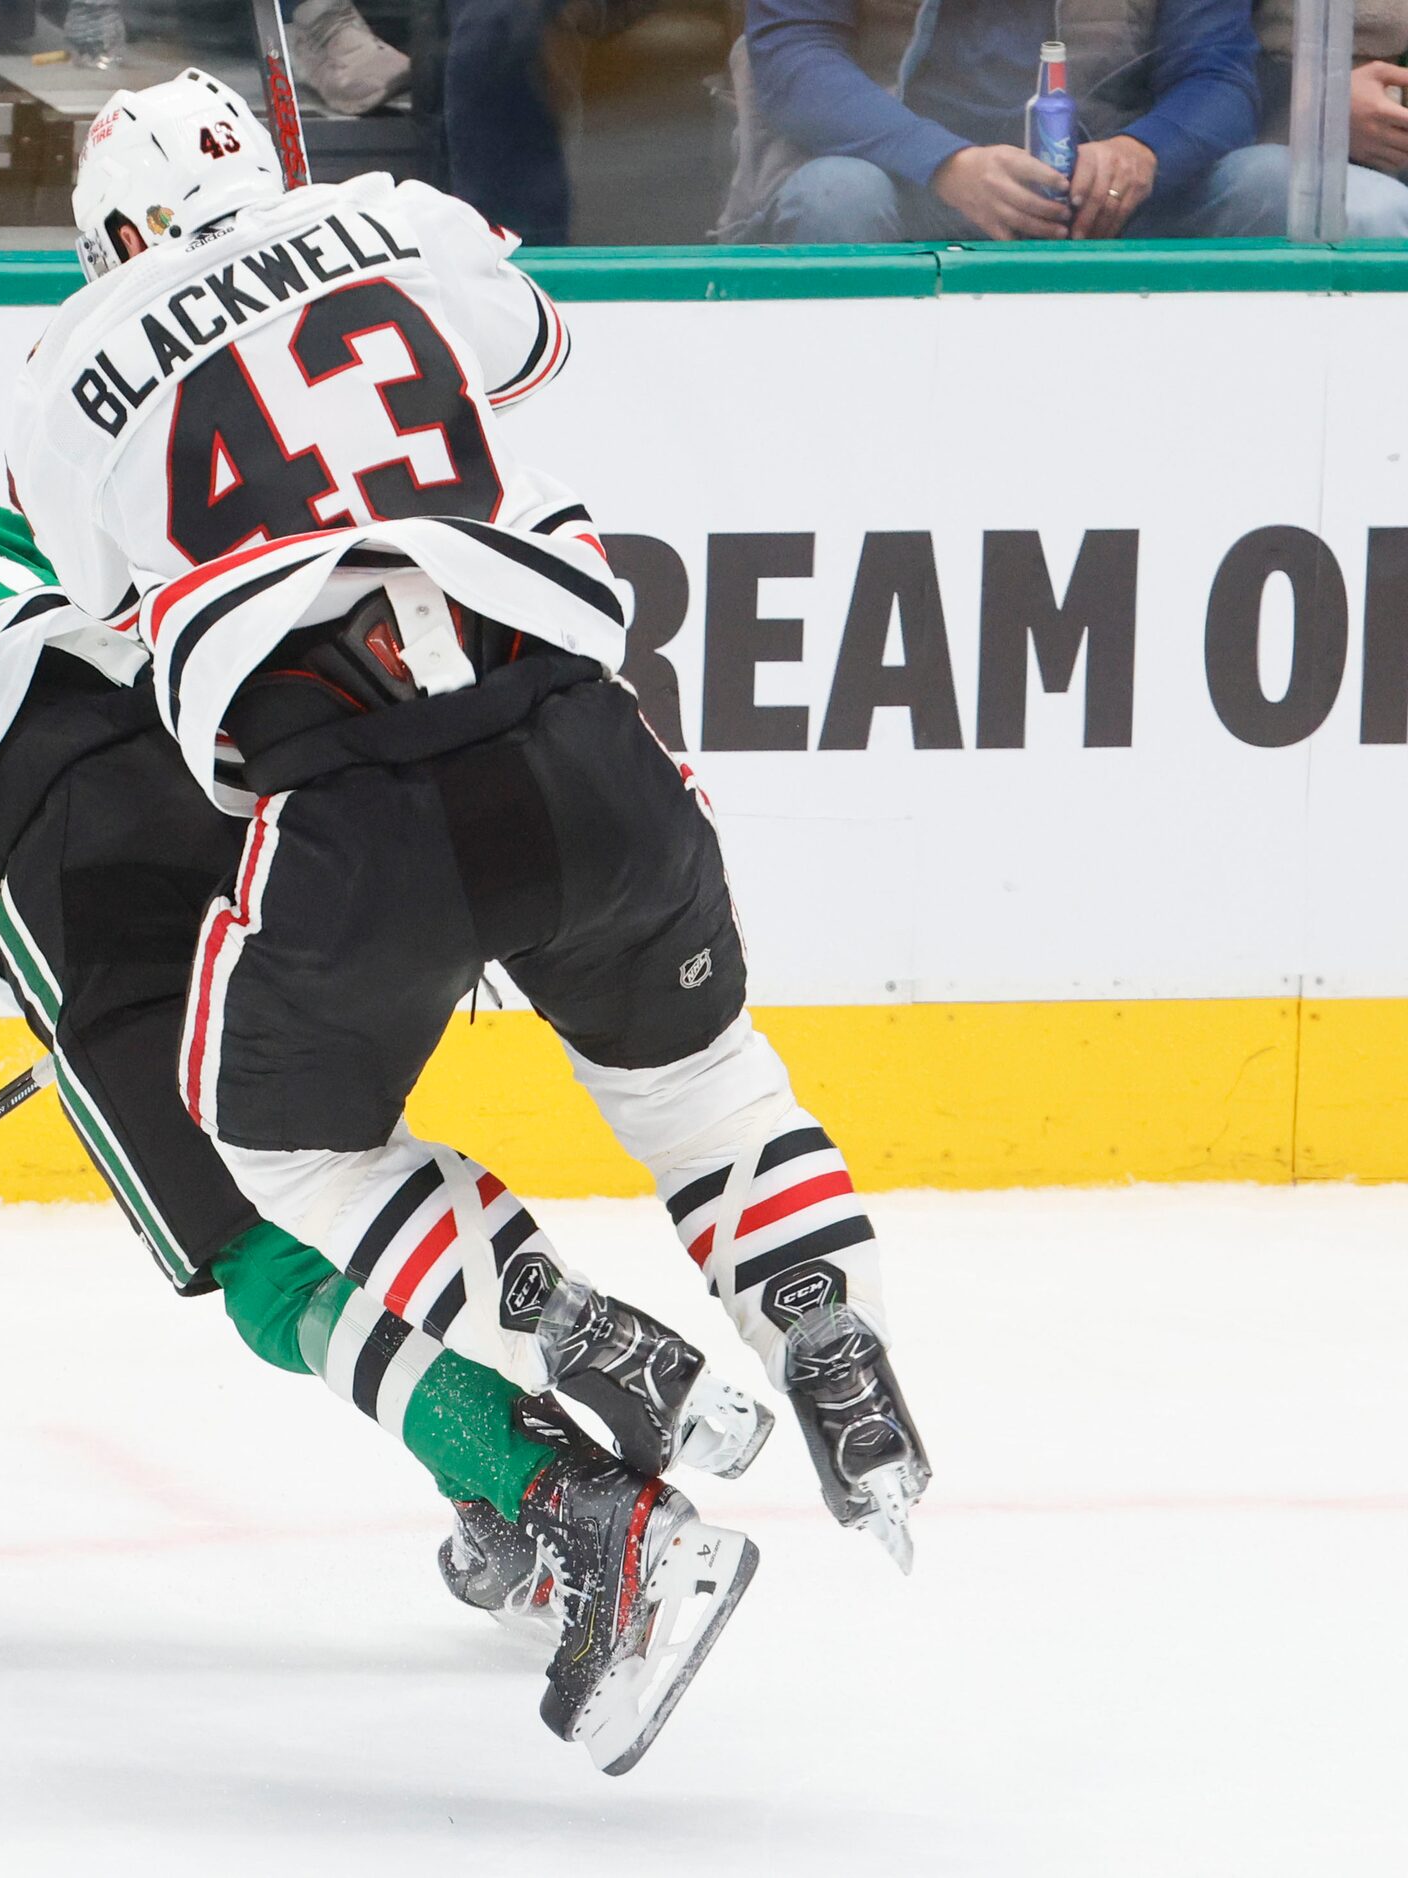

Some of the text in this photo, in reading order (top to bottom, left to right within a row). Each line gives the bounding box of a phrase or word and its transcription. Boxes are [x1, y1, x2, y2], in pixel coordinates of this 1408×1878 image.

[92, 124, 114, 147] TIRE
[199, 120, 241, 160] 43
[185, 226, 235, 252] adidas
[71, 211, 421, 439] BLACKWELL
[165, 275, 505, 567] 43
[598, 528, 1140, 752] REAM
[513, 1267, 539, 1308] CCM
[783, 1279, 824, 1304] CCM
